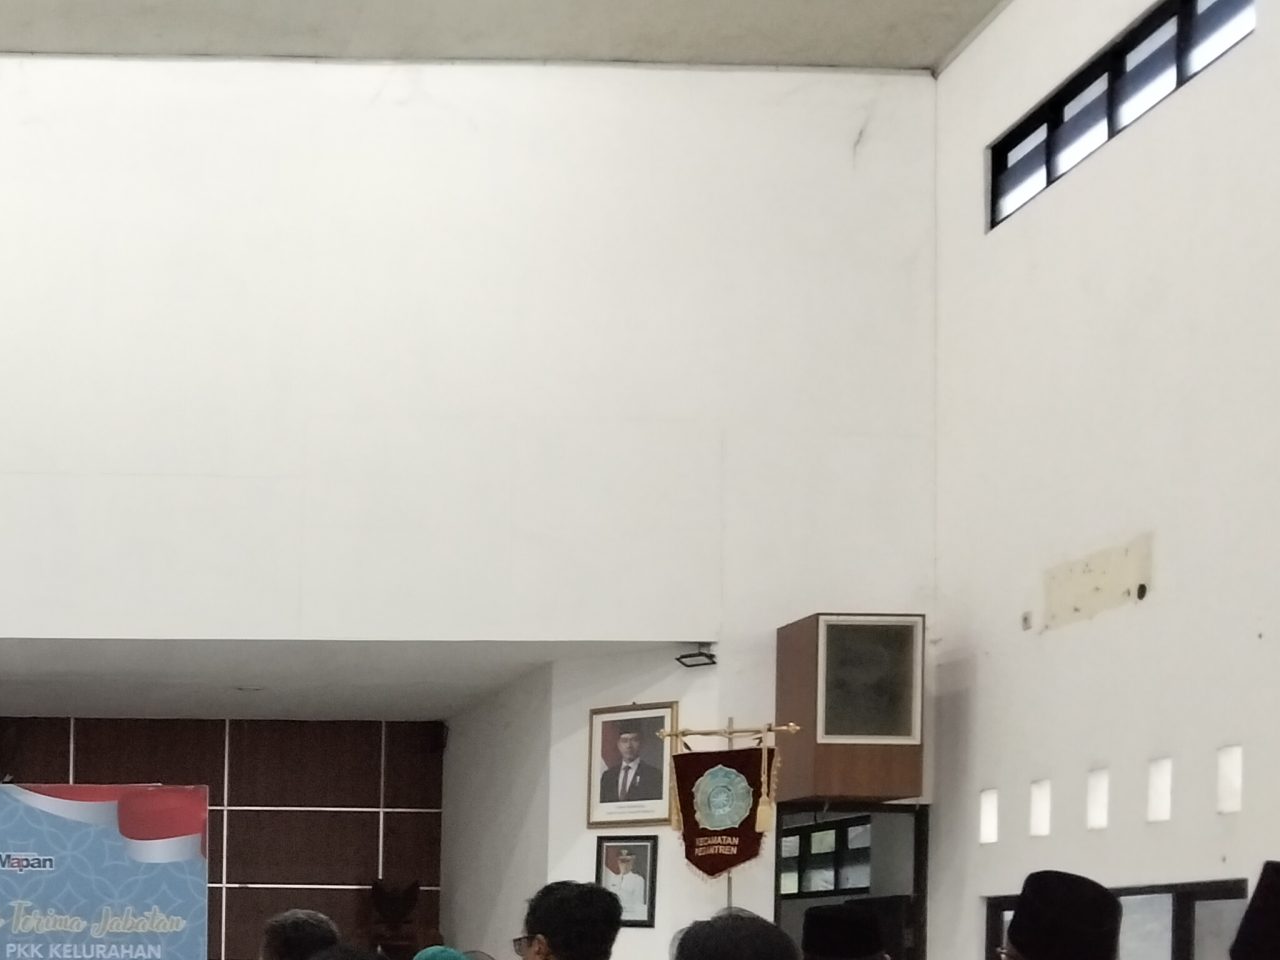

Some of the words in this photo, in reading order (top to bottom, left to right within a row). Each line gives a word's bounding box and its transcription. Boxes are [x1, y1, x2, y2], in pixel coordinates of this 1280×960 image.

[9, 900, 87, 934] Terima
[90, 905, 187, 938] Jabatan
[6, 943, 43, 959] PKK
[49, 944, 162, 960] KELURAHAN
